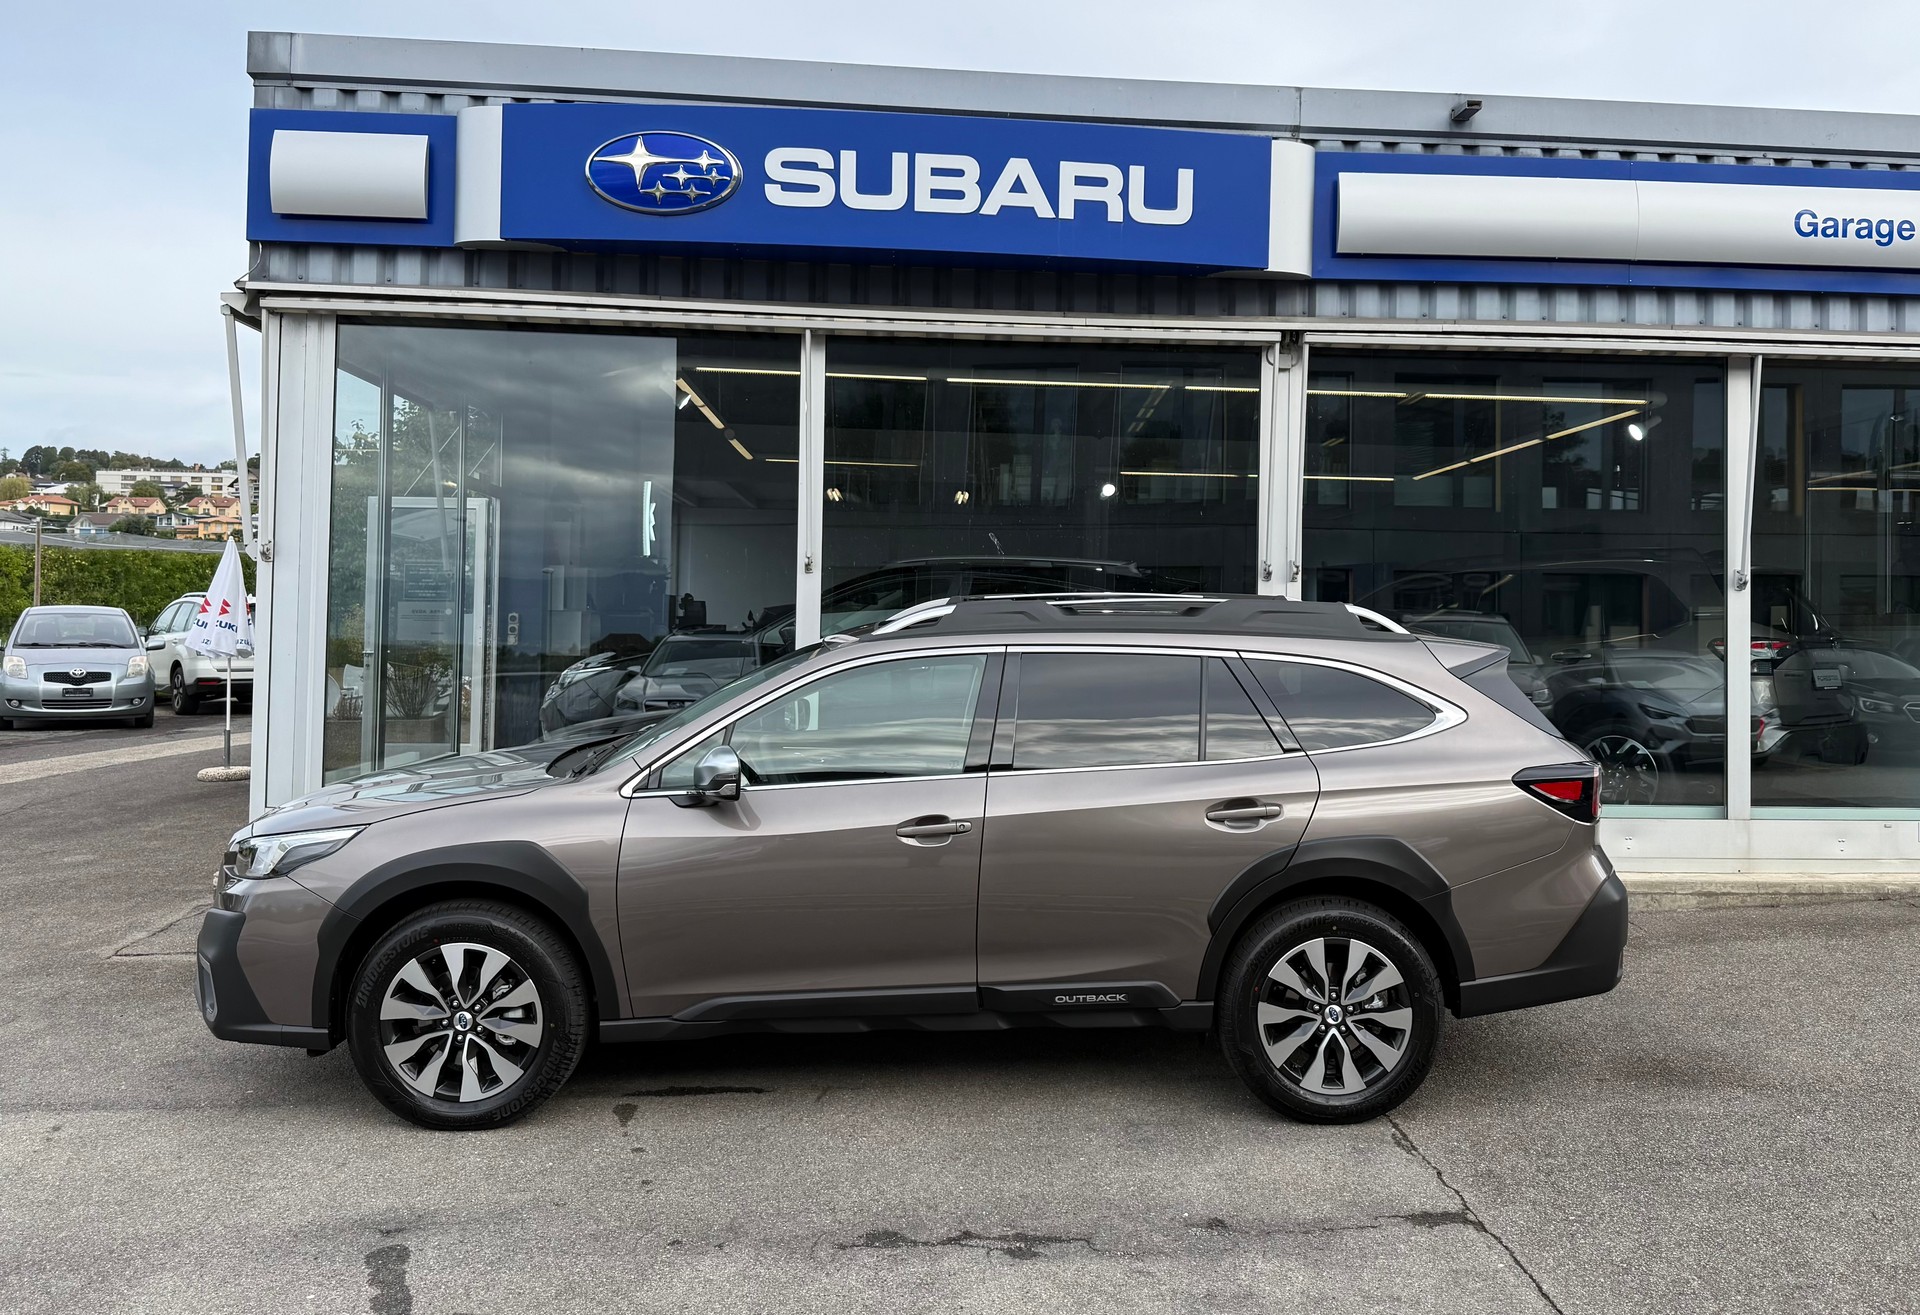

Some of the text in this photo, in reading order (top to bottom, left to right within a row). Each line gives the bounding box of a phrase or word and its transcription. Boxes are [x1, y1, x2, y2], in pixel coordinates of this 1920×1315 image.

[764, 147, 1194, 225] SUBARU
[1794, 209, 1916, 247] Garage
[1054, 993, 1127, 1004] OUTBACK
